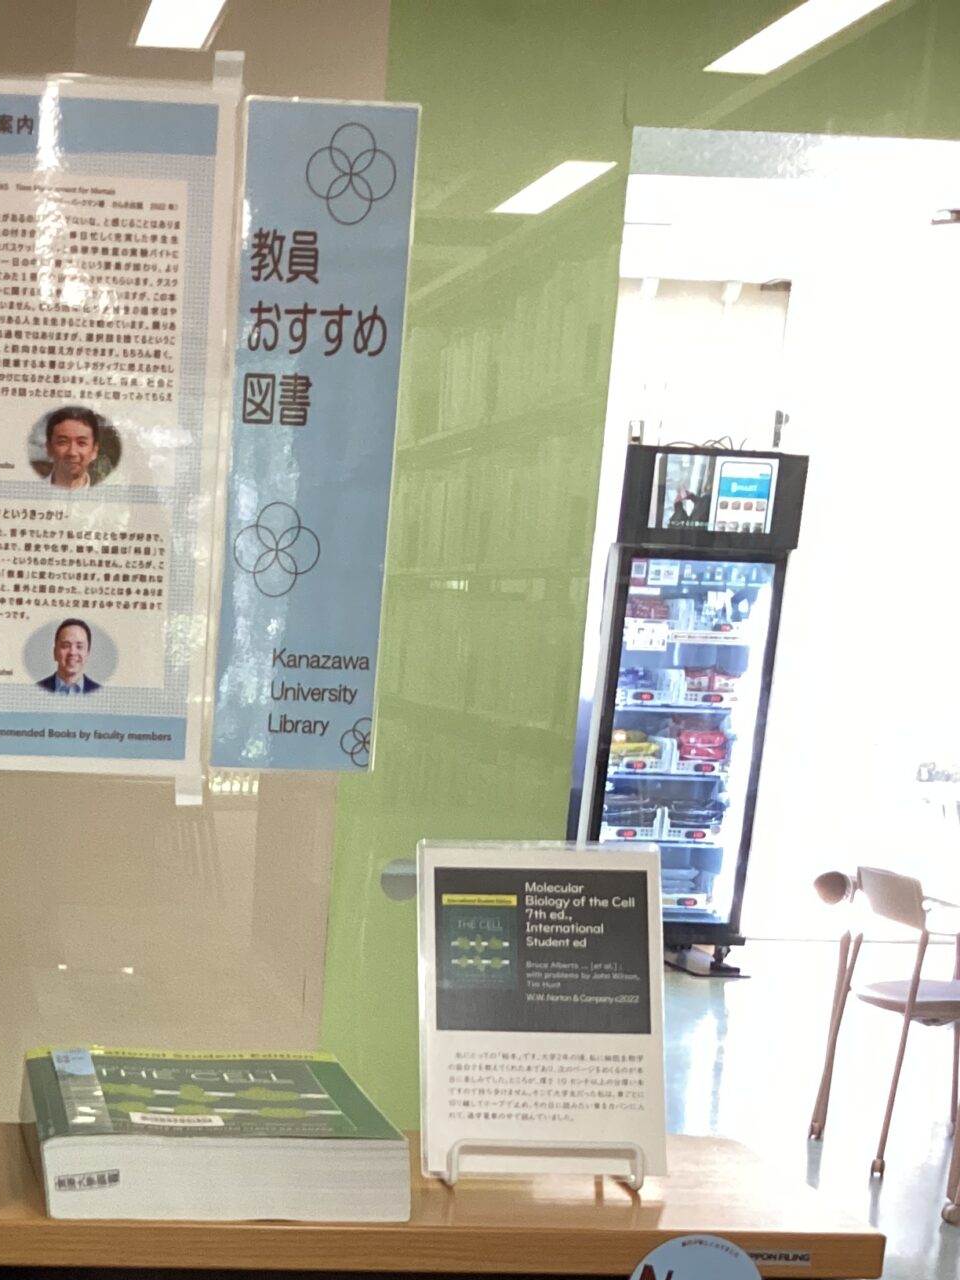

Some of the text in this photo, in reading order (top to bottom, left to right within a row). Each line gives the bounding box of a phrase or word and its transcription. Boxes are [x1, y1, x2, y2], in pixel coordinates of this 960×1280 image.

[250, 227, 319, 284] 教員
[247, 300, 387, 357] おすすめ
[242, 372, 313, 426] 図書
[272, 647, 370, 671] Kanazawa
[270, 680, 358, 705] University
[267, 712, 330, 737] Library
[48, 728, 76, 739] Books
[79, 730, 91, 741] by
[93, 730, 125, 742] faculty
[127, 731, 172, 742] members
[524, 881, 585, 894] Molecular
[524, 895, 636, 909] Biology of the Cell
[525, 908, 547, 920] 7th
[525, 921, 604, 935] International
[526, 936, 587, 948] Student ed
